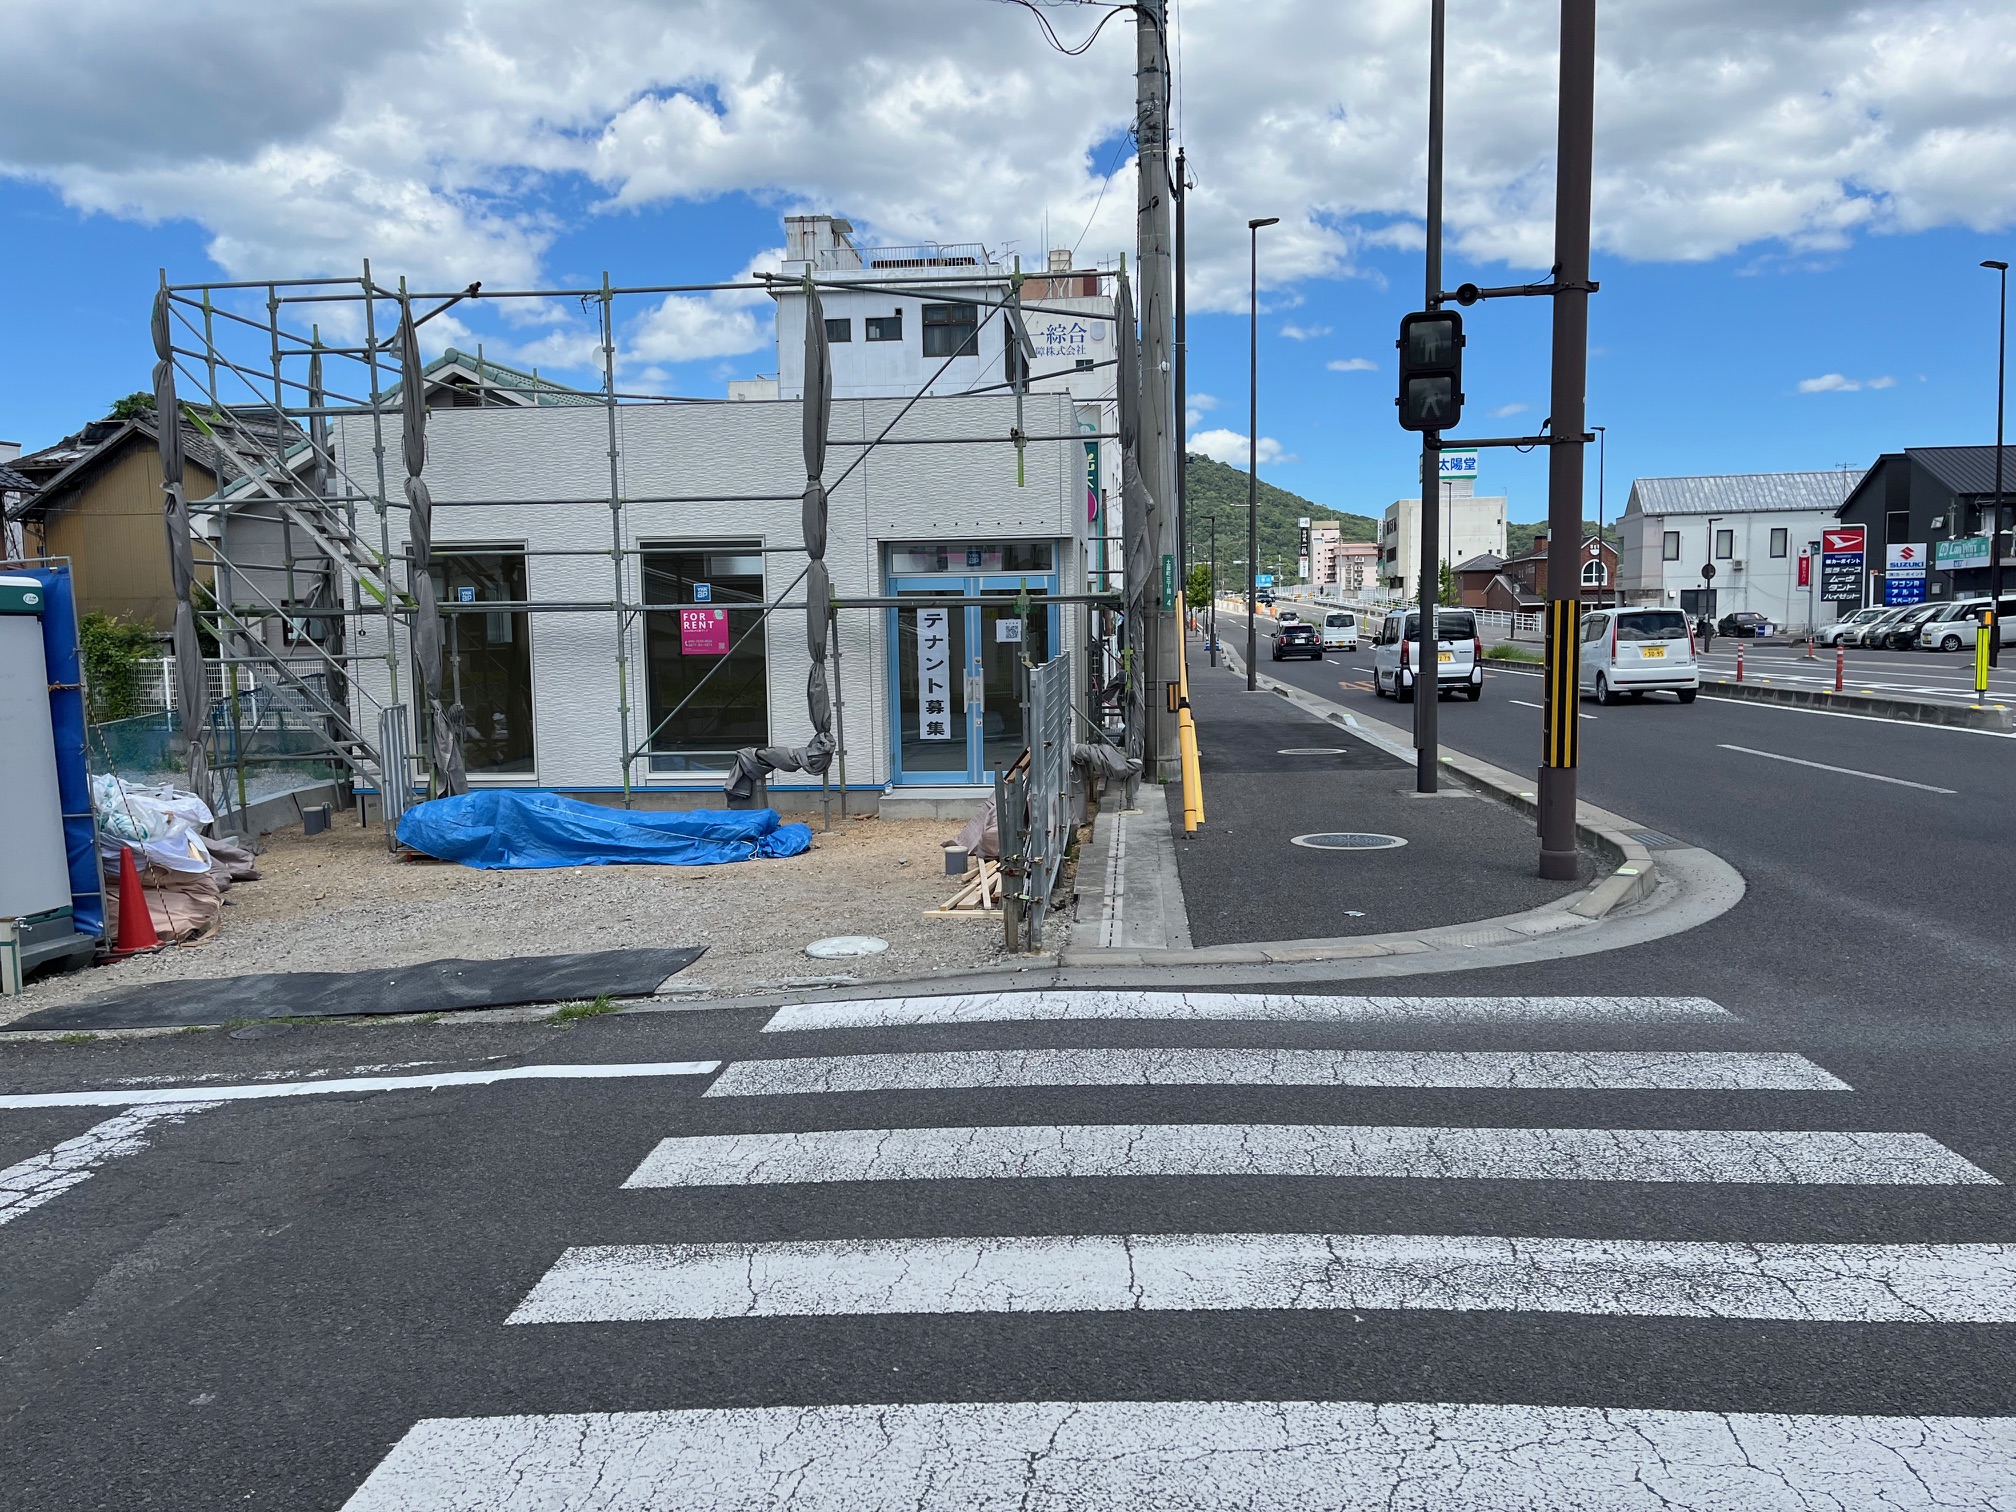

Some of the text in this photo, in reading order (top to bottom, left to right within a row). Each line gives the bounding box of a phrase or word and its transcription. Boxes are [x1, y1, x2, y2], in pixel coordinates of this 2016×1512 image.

[1439, 457, 1476, 471] 太陽堂
[1828, 584, 1856, 592] タント
[1891, 580, 1920, 588] ワゴンR
[683, 612, 707, 621] FOR
[683, 621, 715, 630] RENT
[924, 613, 945, 736] テナント募集
